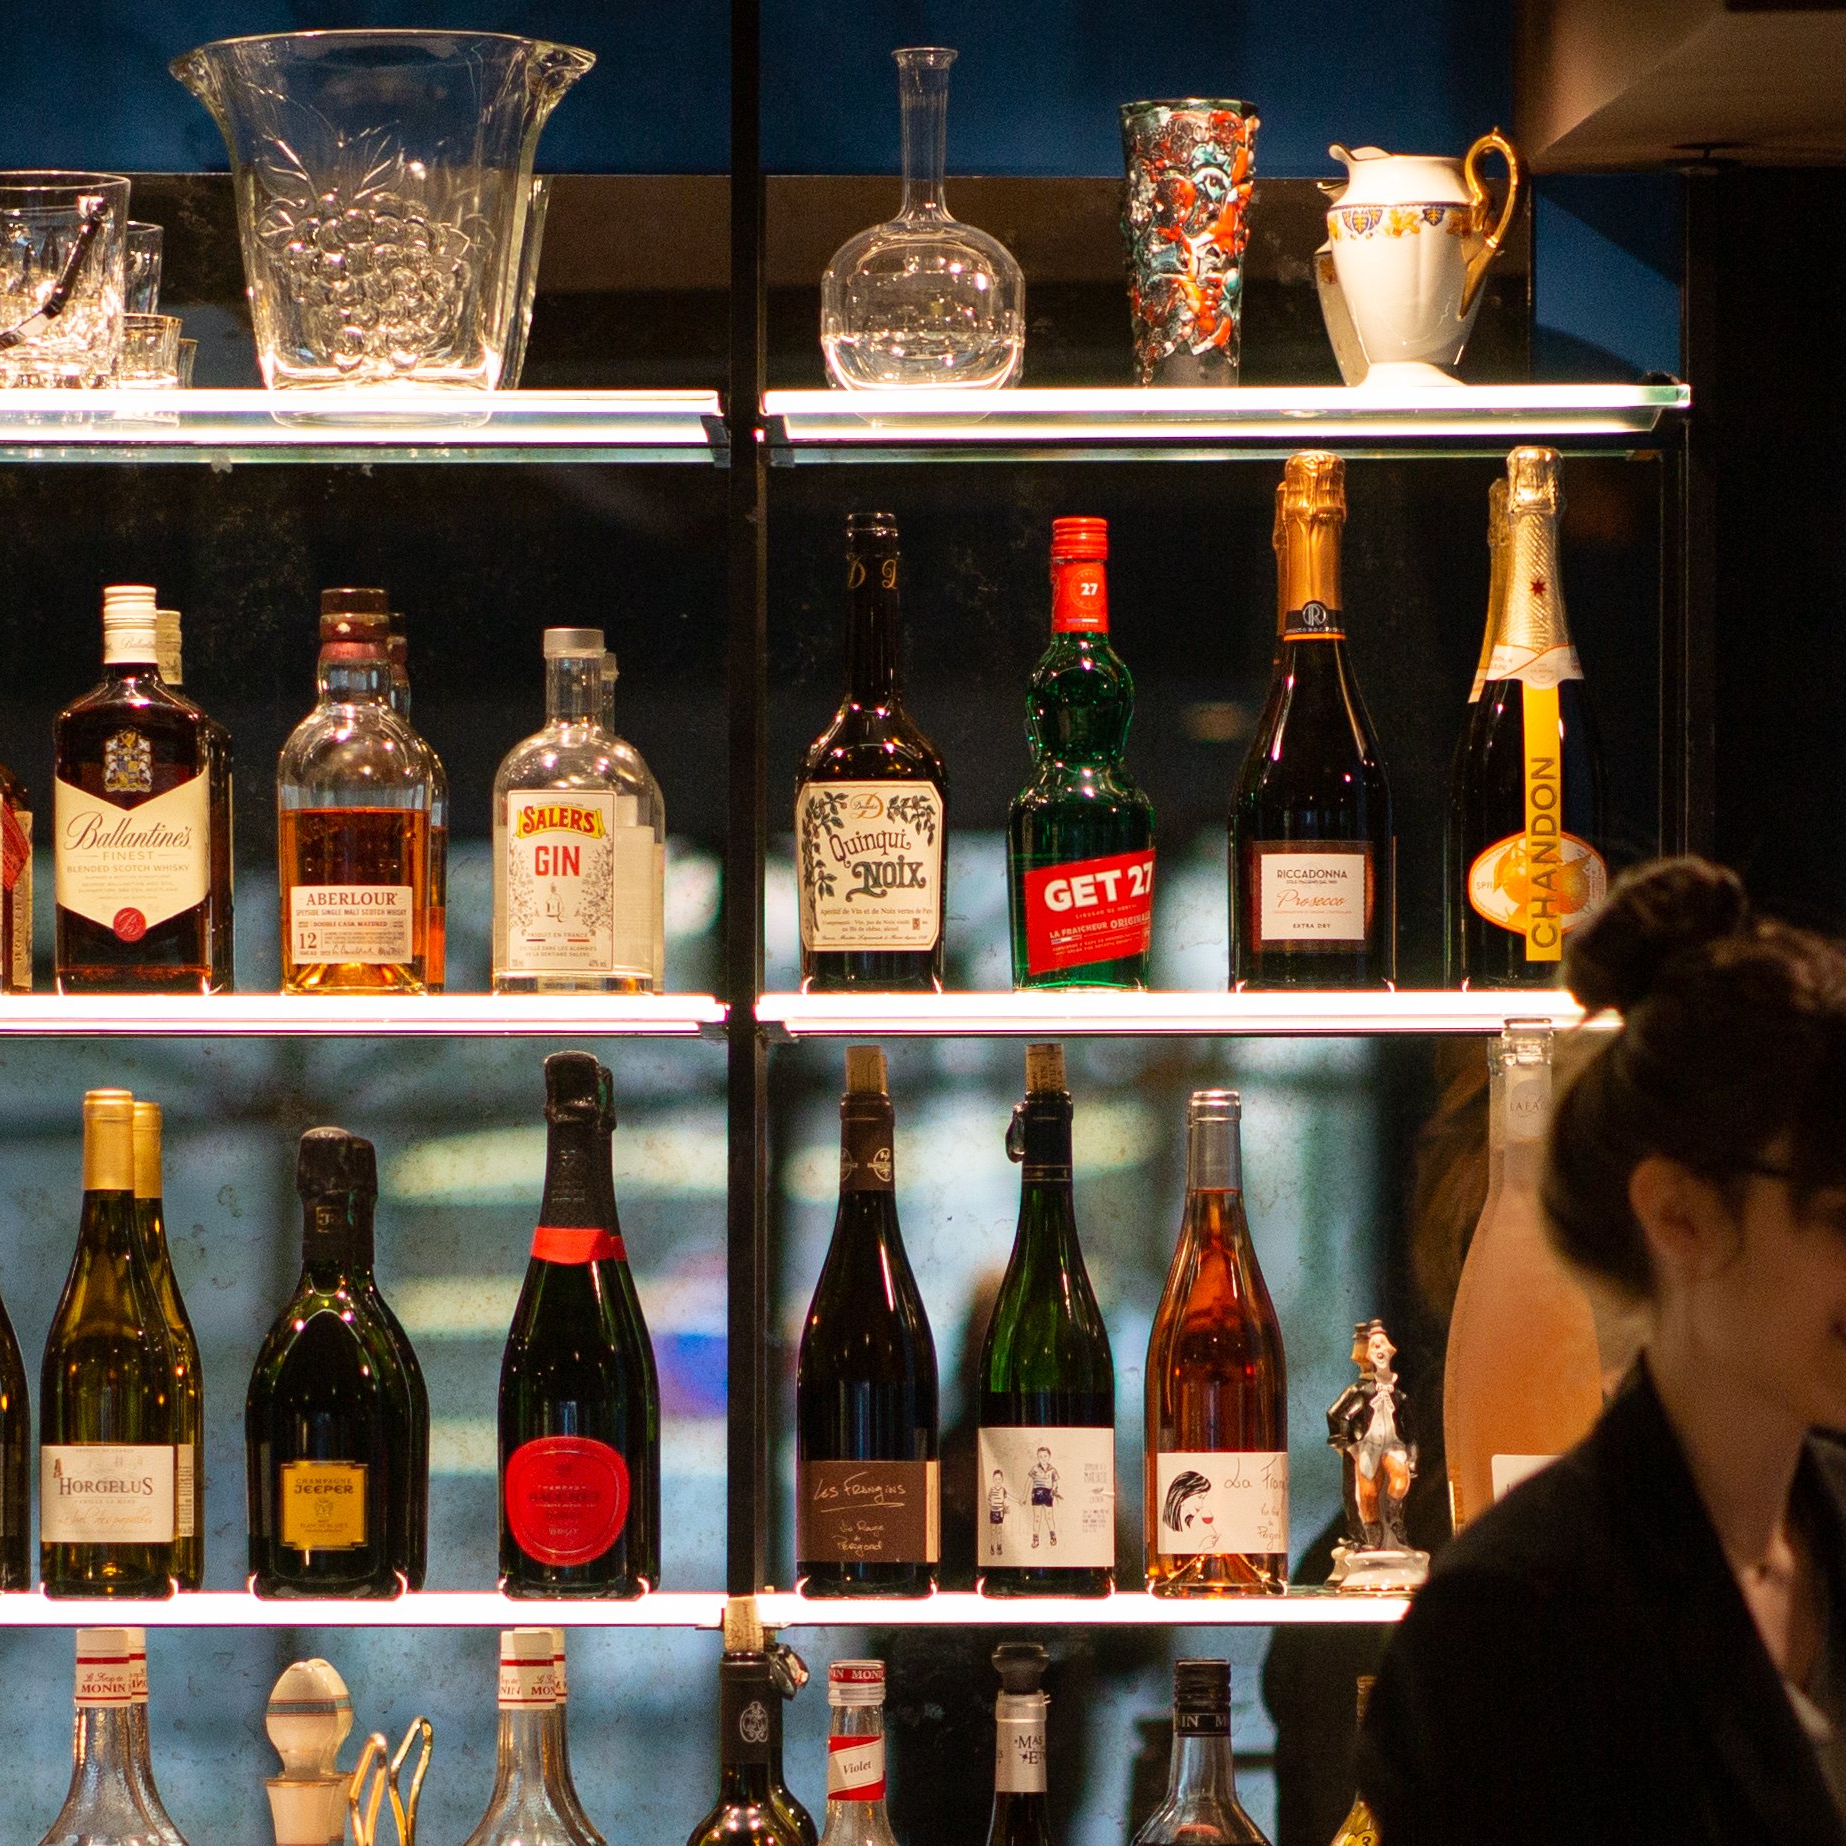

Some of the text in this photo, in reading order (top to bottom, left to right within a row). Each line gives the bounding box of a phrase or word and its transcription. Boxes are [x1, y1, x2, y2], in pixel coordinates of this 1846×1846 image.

[1080, 582, 1099, 596] 27
[522, 805, 595, 835] SALERS
[64, 811, 192, 851] Ballantine's
[102, 850, 155, 861] FINEST
[829, 828, 912, 868] Quinqui
[1530, 756, 1557, 949] CHANDON
[66, 863, 190, 874] BLENDED SCOTCH WHISKY
[534, 845, 581, 877] GIN
[1276, 869, 1348, 879] RICCADONNA
[1043, 860, 1154, 912] GET 27
[306, 891, 396, 906] ABERLOUR
[1276, 888, 1347, 908] Prosecco
[343, 909, 359, 917] MALT
[1049, 921, 1108, 939] LA FRAICHEUR
[1292, 922, 1332, 930] EXTRA DRY
[298, 931, 317, 949] 12
[1224, 1457, 1253, 1489] La
[293, 1484, 354, 1495] JEEPER
[813, 1478, 839, 1500] Les
[81, 1683, 126, 1694] MONIN
[1018, 1735, 1043, 1749] MAS
[843, 1760, 872, 1775] Violet
